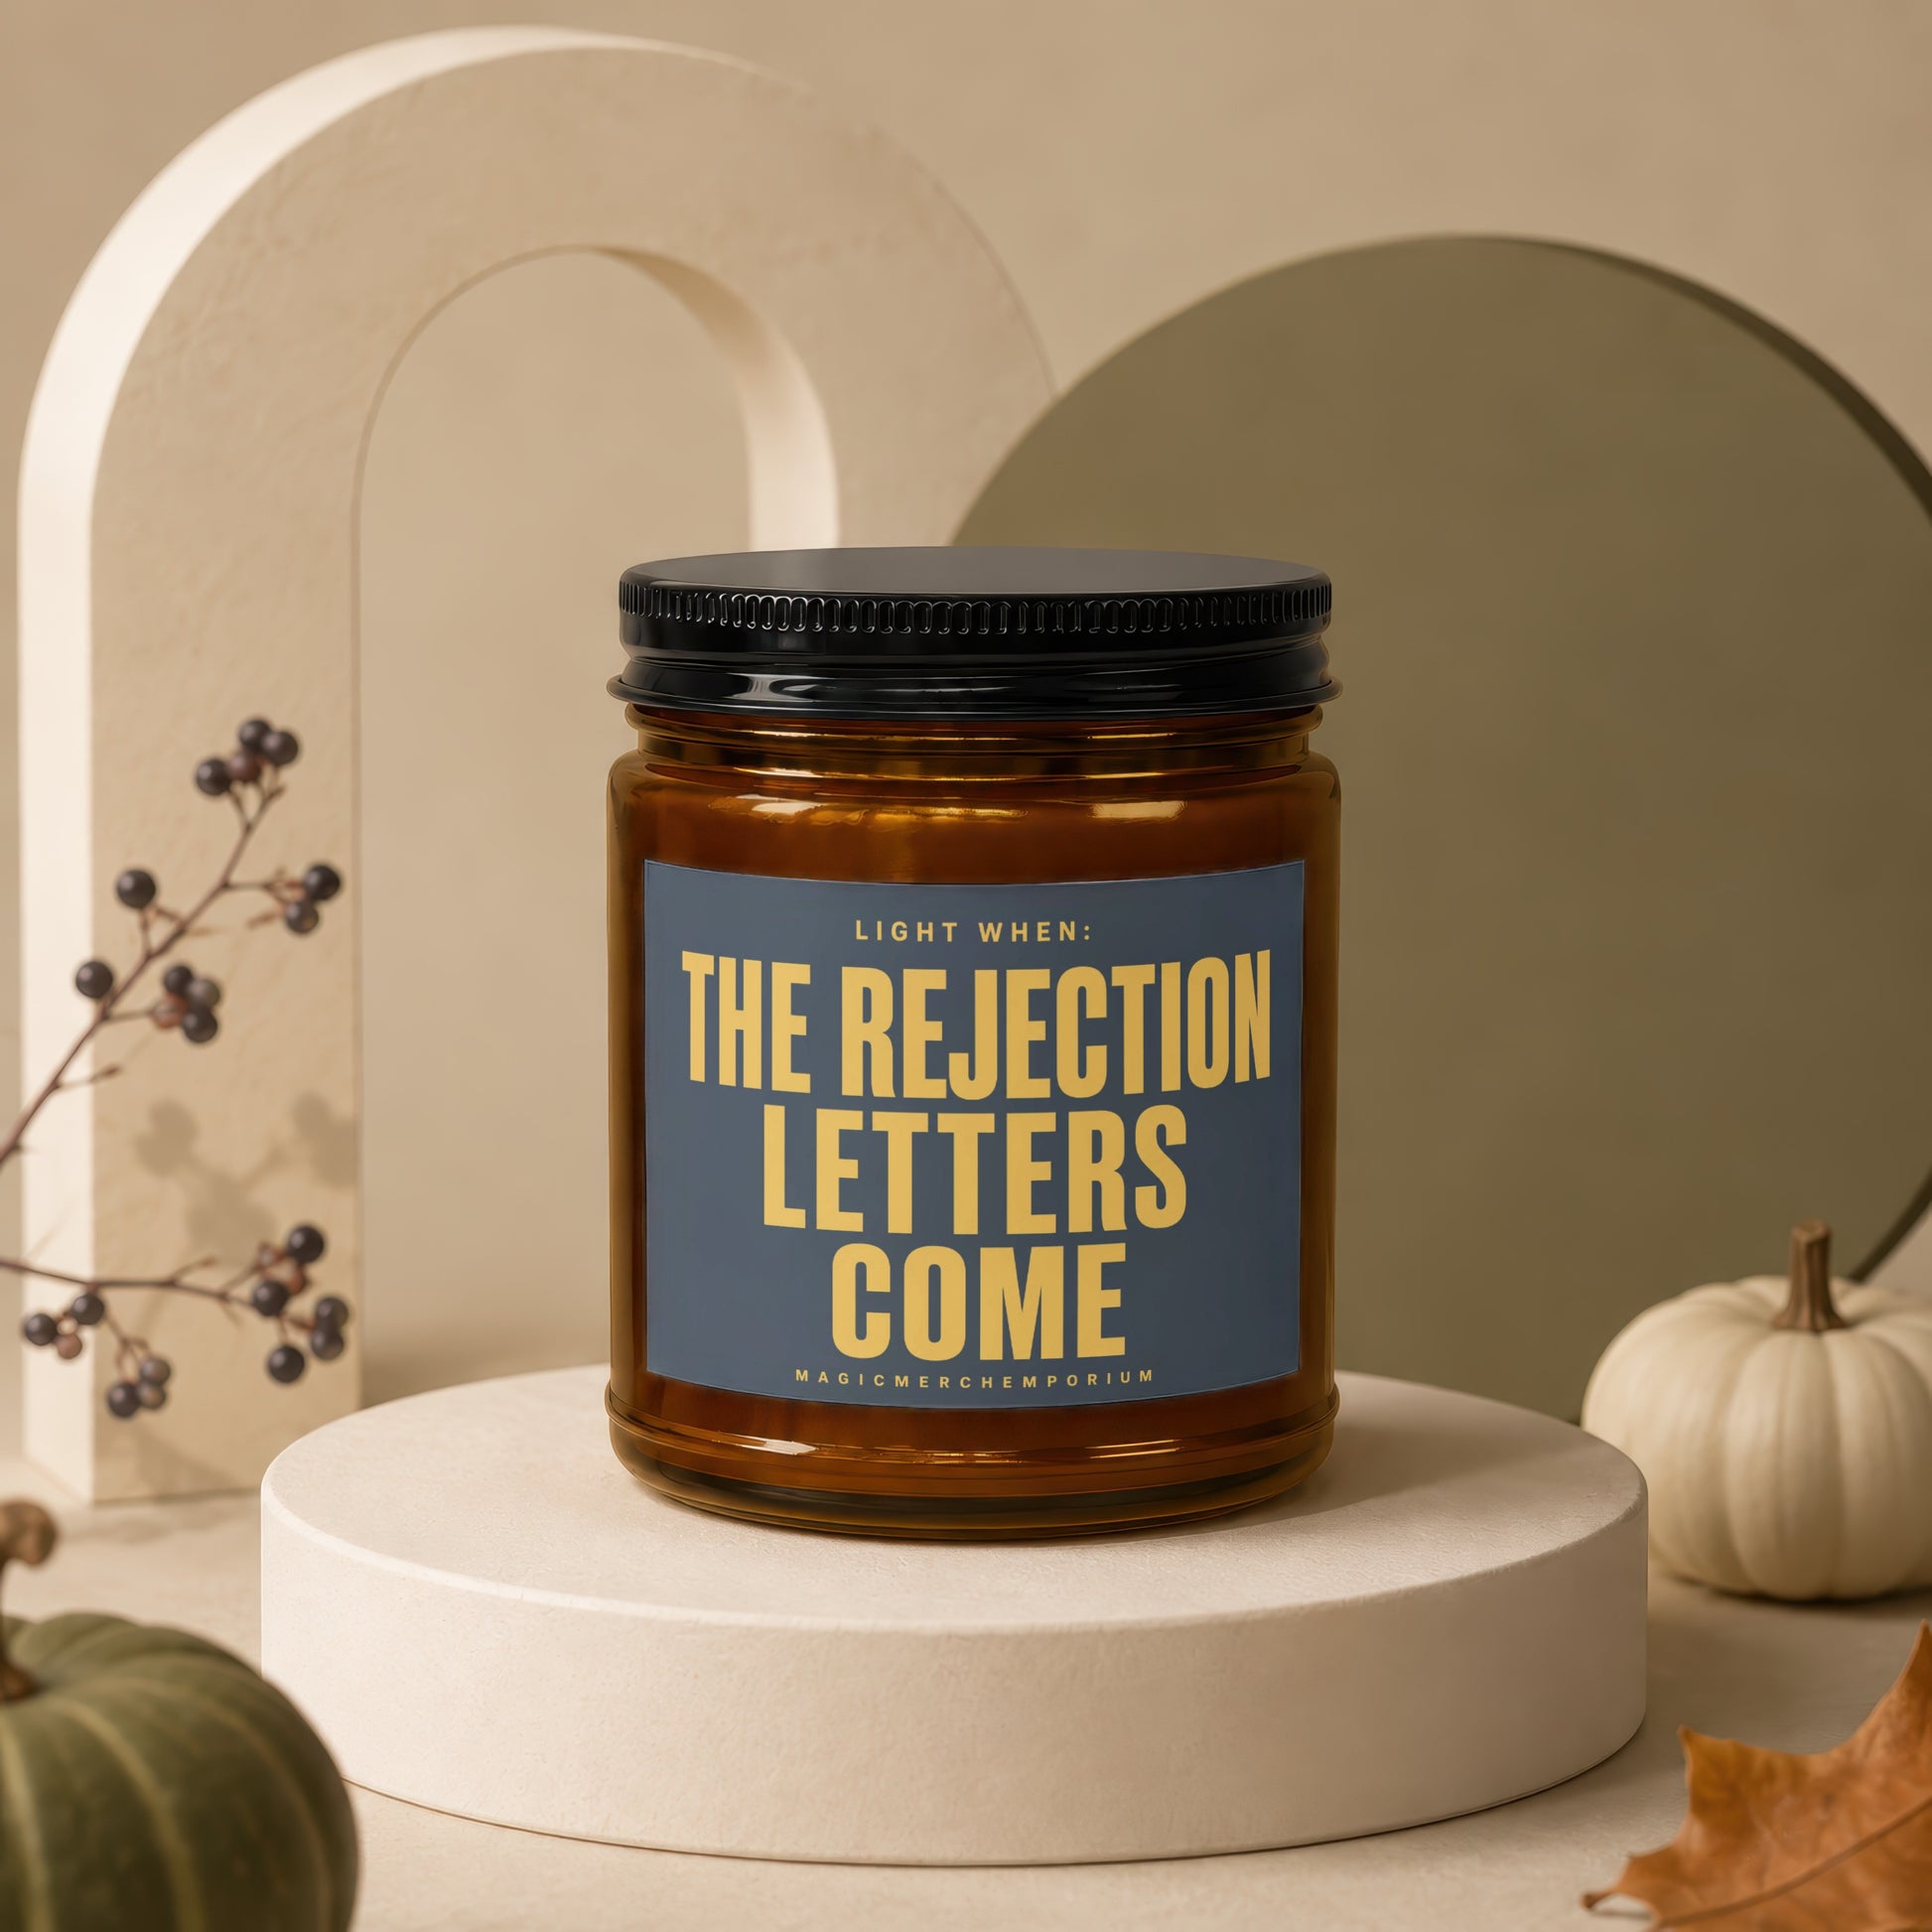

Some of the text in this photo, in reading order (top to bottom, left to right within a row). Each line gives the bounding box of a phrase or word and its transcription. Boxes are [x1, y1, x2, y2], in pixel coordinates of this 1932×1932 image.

[855, 919, 1091, 943] LIGHT WHEN:
[681, 948, 1272, 1102] THE REJECTION
[762, 1103, 1188, 1237] LETTERS
[831, 1241, 1128, 1363] COME
[794, 1368, 1155, 1390] MAGICMERCHEMPORIUM
